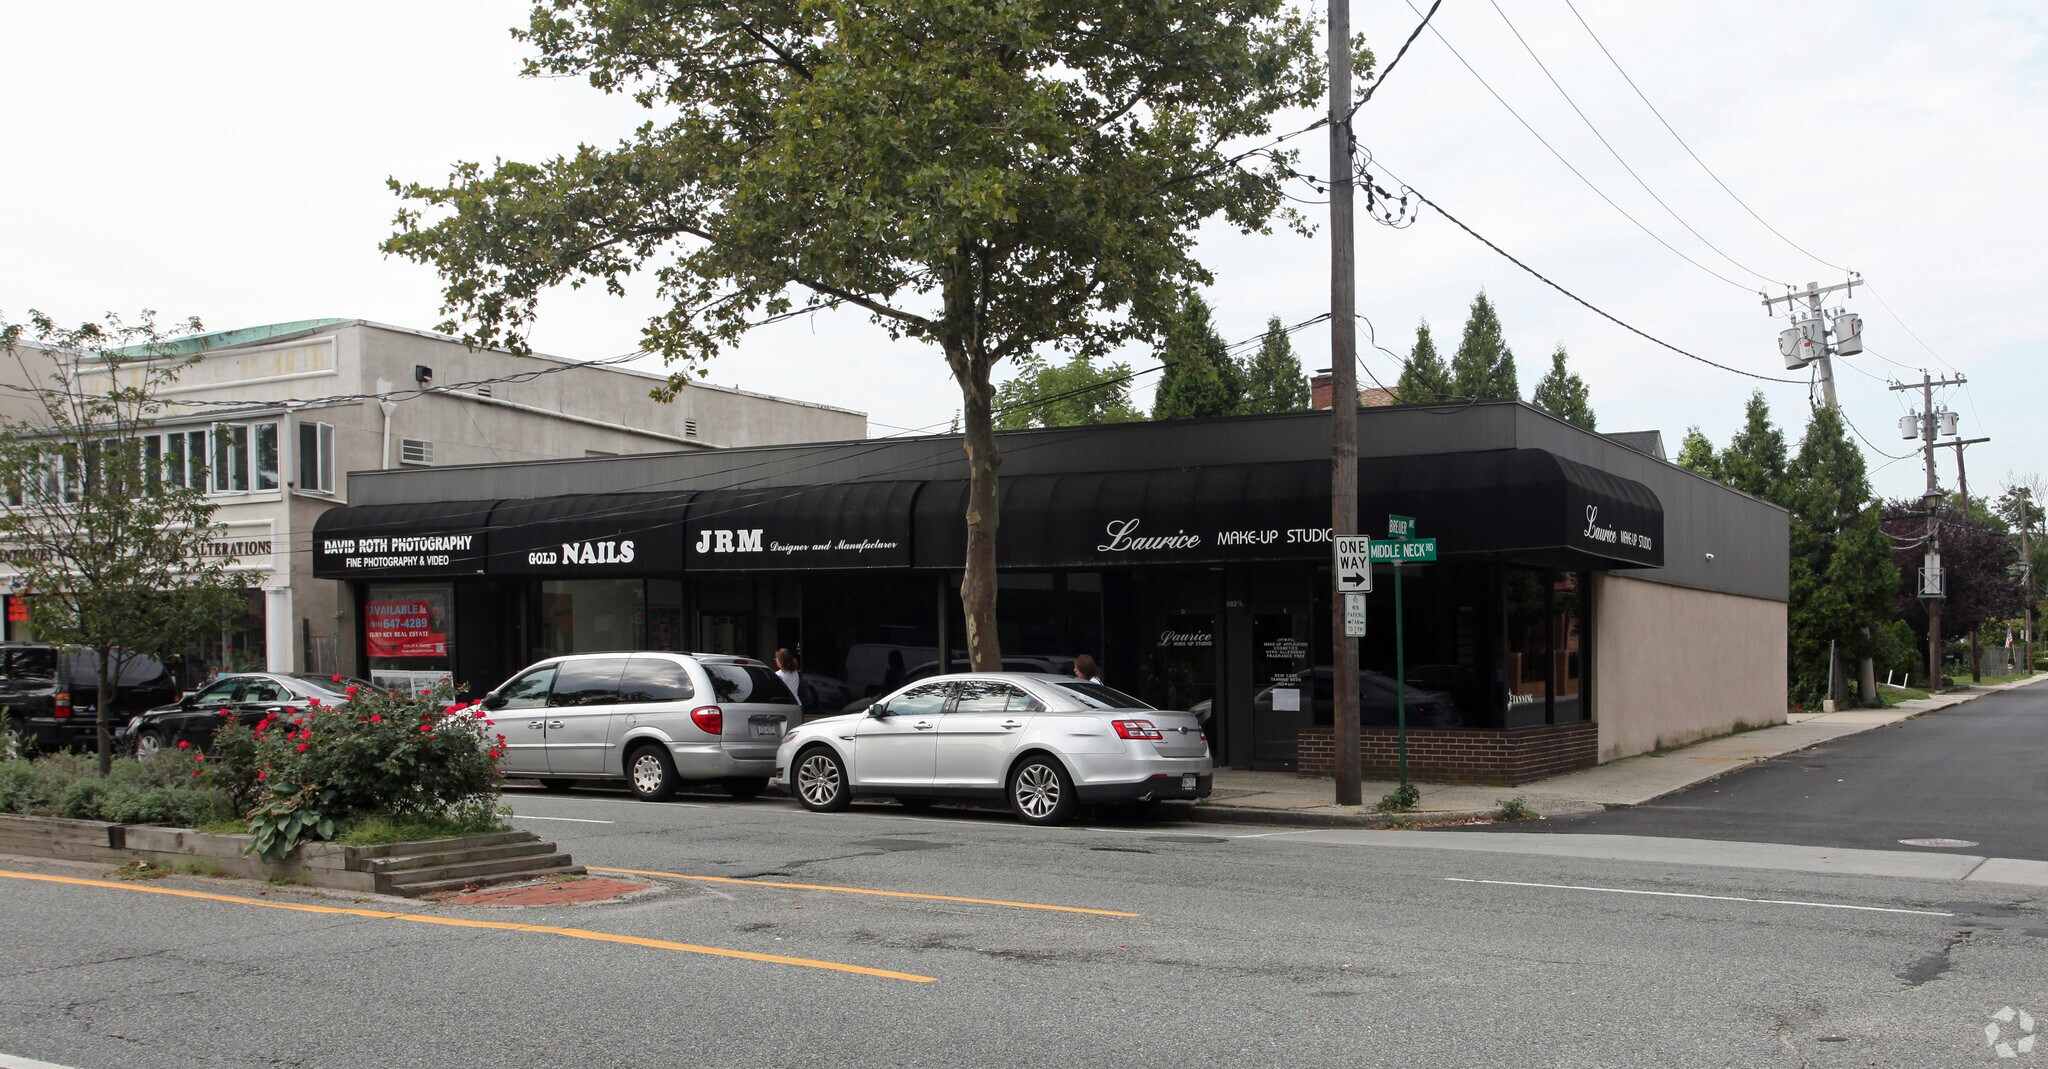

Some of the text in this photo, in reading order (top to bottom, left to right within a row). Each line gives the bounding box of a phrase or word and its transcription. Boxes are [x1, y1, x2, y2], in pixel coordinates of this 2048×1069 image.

[1097, 518, 1201, 551] Laurice
[1217, 529, 1279, 546] MAKE-UP
[1389, 519, 1408, 535] BREUER
[1584, 504, 1652, 551] Laurice MAKE-UP STUDIO
[194, 540, 272, 556] ALTERATIONS
[324, 535, 473, 555] DAVID ROTH PHOTOGRAPHY
[695, 528, 898, 555] JRM Designer and Manufacturer
[1340, 540, 1366, 554] ONE
[528, 540, 635, 565] GOLD NAILS
[1370, 542, 1434, 558] MIDDLE NECK RD
[346, 555, 450, 568] FINE PHOTOGRAPHY & VIDEO
[1340, 556, 1367, 570] WAY
[368, 605, 418, 615] AVAILABLE
[383, 618, 428, 629] 647-4289
[1157, 630, 1212, 647] Laurice
